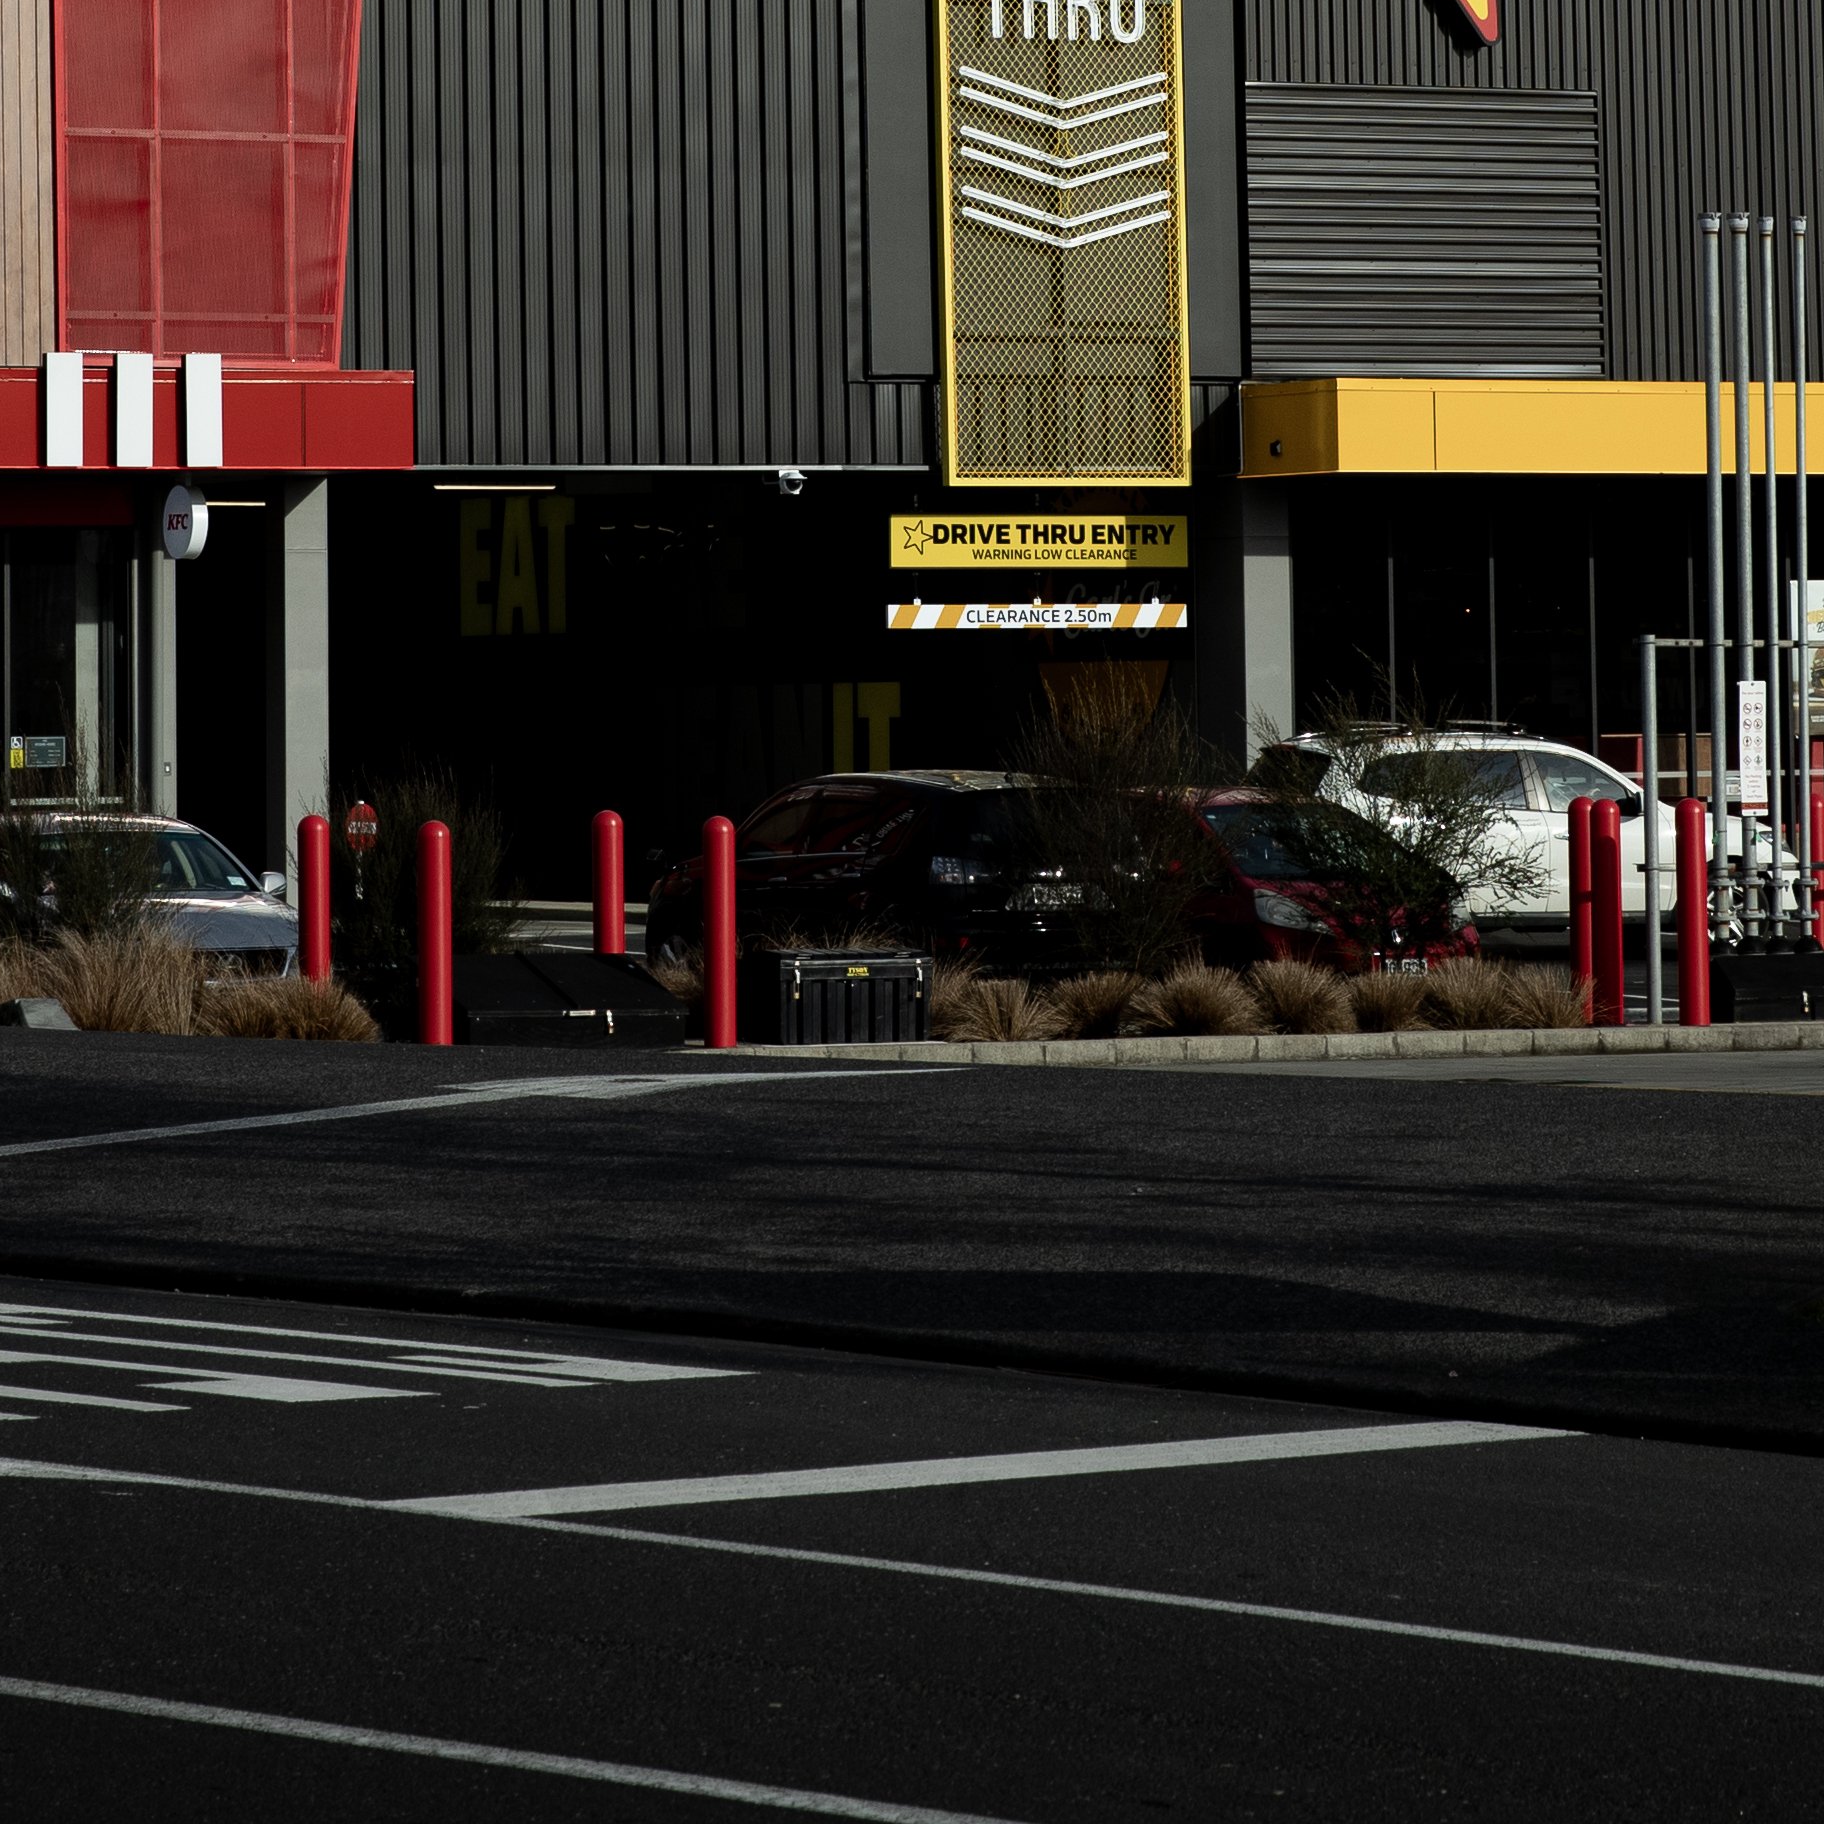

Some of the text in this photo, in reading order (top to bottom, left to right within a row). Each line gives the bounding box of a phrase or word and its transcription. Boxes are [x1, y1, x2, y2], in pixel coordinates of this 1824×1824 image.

[167, 512, 188, 531] KFC
[932, 523, 1175, 546] DRIVE THRU ENTRY
[972, 548, 1138, 561] WARNING LOW CLEARANCE
[460, 495, 576, 638] EAT
[966, 609, 1112, 623] CLEARANCE 2.50m
